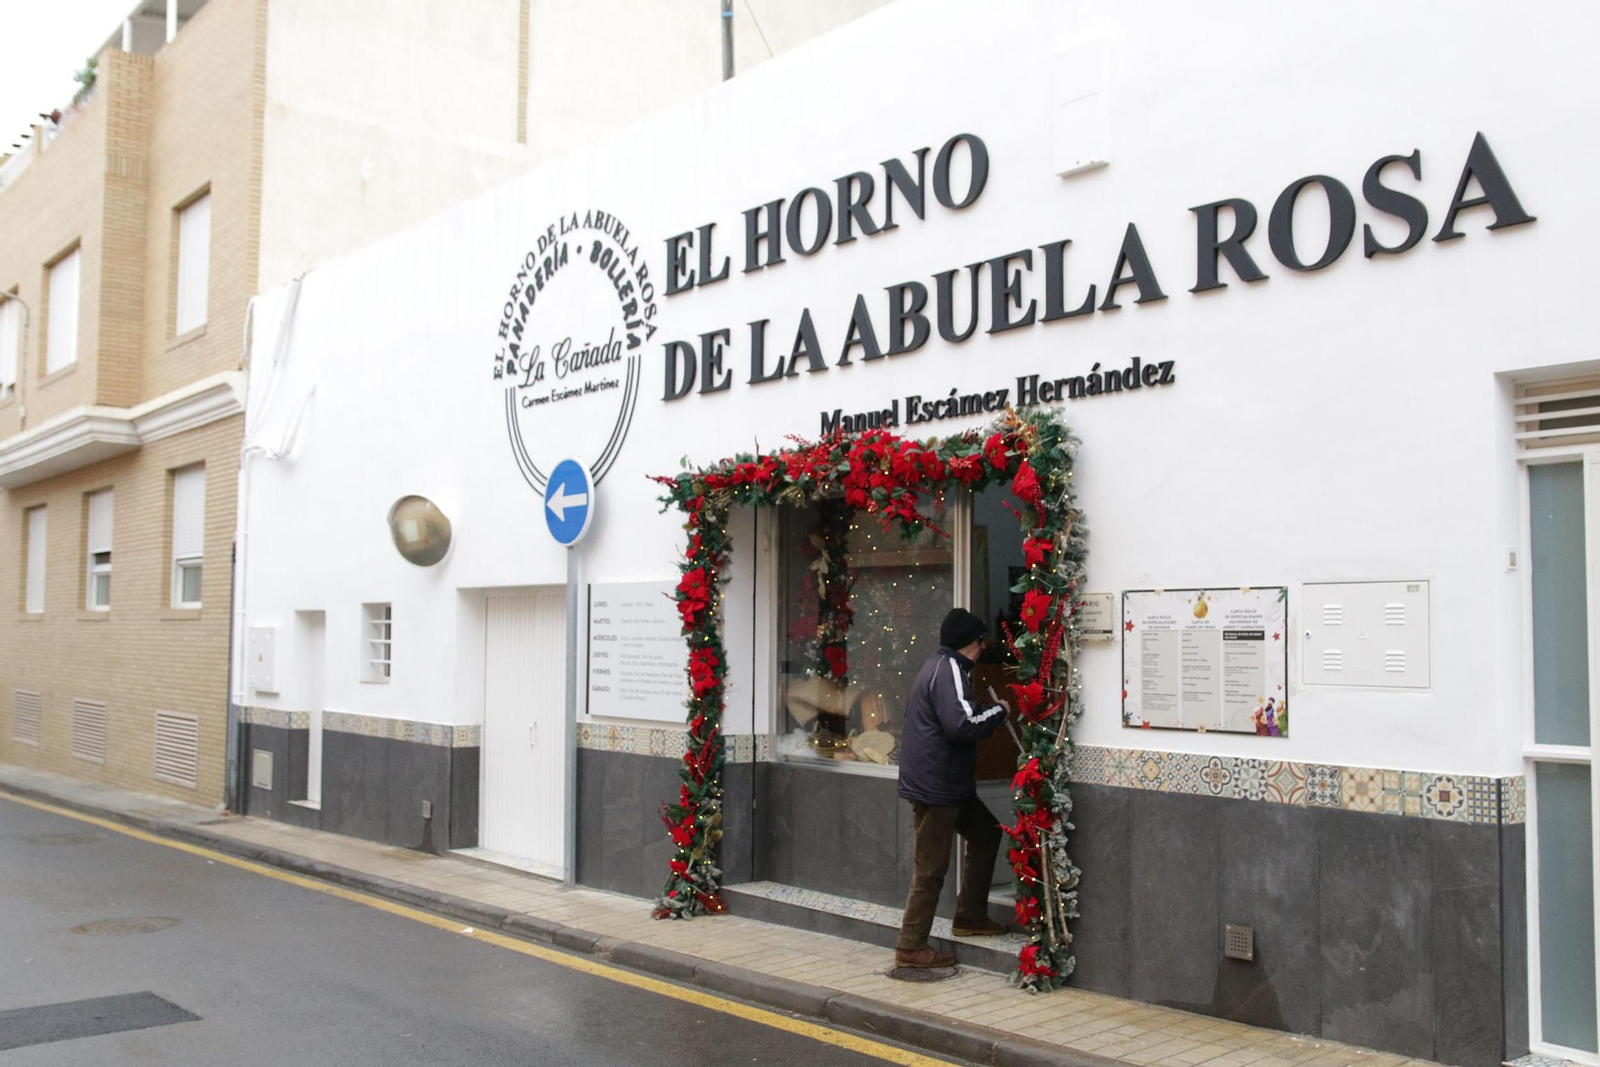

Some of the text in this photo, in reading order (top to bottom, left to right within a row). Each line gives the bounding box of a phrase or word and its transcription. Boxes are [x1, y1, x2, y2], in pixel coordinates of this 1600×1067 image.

[660, 131, 1537, 401] DE LA ABUELA ROSA
[663, 133, 989, 296] EL HORNO
[493, 209, 658, 380] EL HORNO DE LA ABUELA ROSA
[506, 240, 644, 375] PANADERÍA BOLLERÍA
[518, 326, 622, 389] La Cañada
[522, 396, 549, 409] Carmen
[820, 356, 1175, 437] Manuel Escámez Hernández
